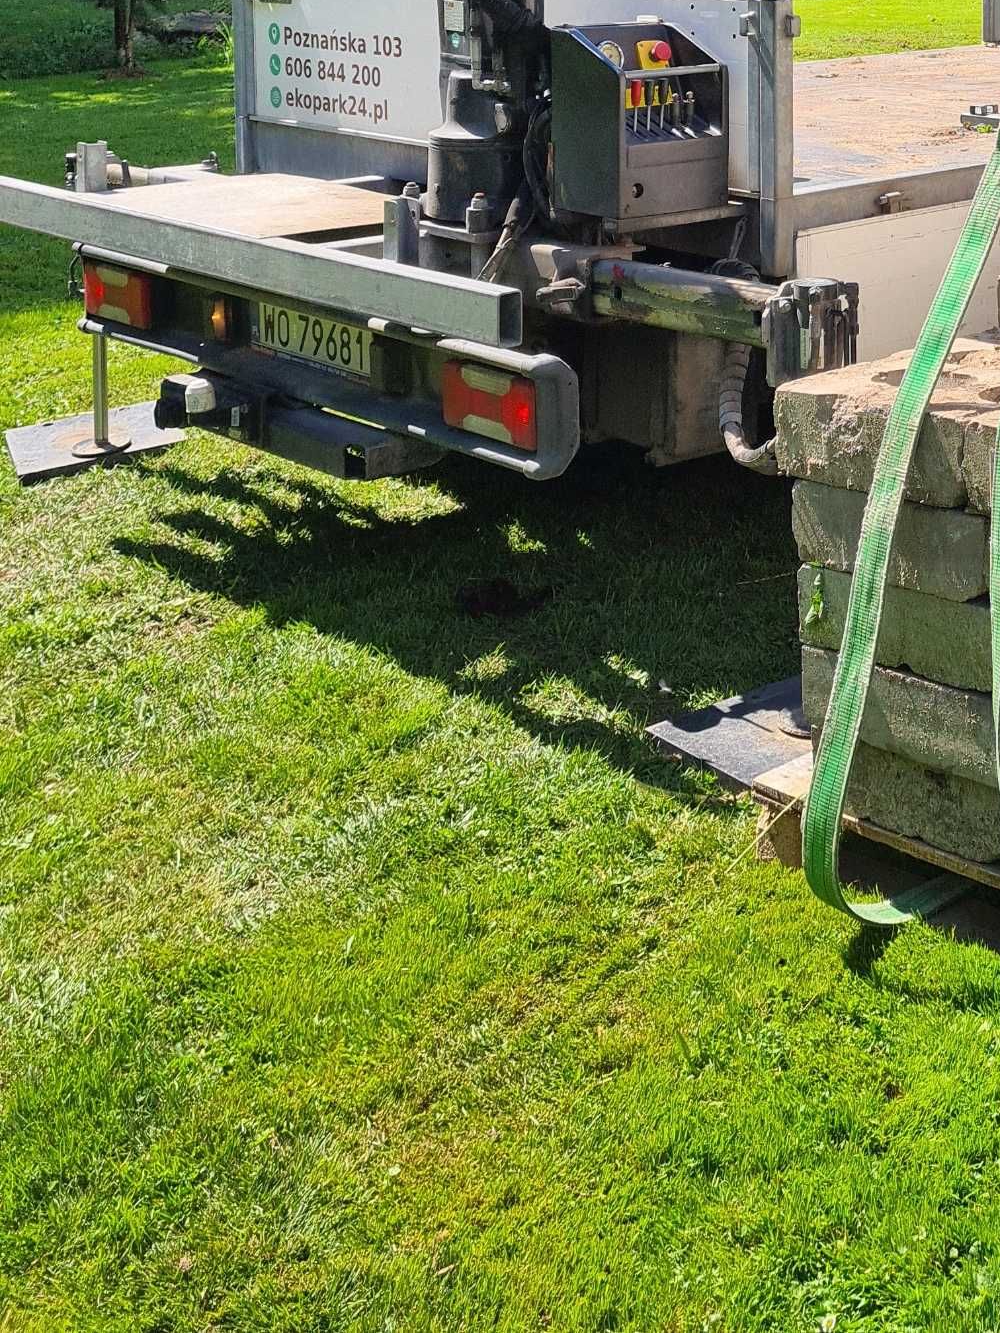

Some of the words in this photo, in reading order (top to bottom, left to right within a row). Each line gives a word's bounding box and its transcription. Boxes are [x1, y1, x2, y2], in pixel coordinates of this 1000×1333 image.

[283, 26, 366, 54] Poznańska
[372, 35, 402, 58] 103
[285, 57, 312, 78] 606
[317, 60, 346, 83] 844
[351, 64, 381, 87] 200
[285, 88, 388, 124] ekopark24.pl
[263, 305, 290, 347] WO
[298, 314, 363, 371] 79681
